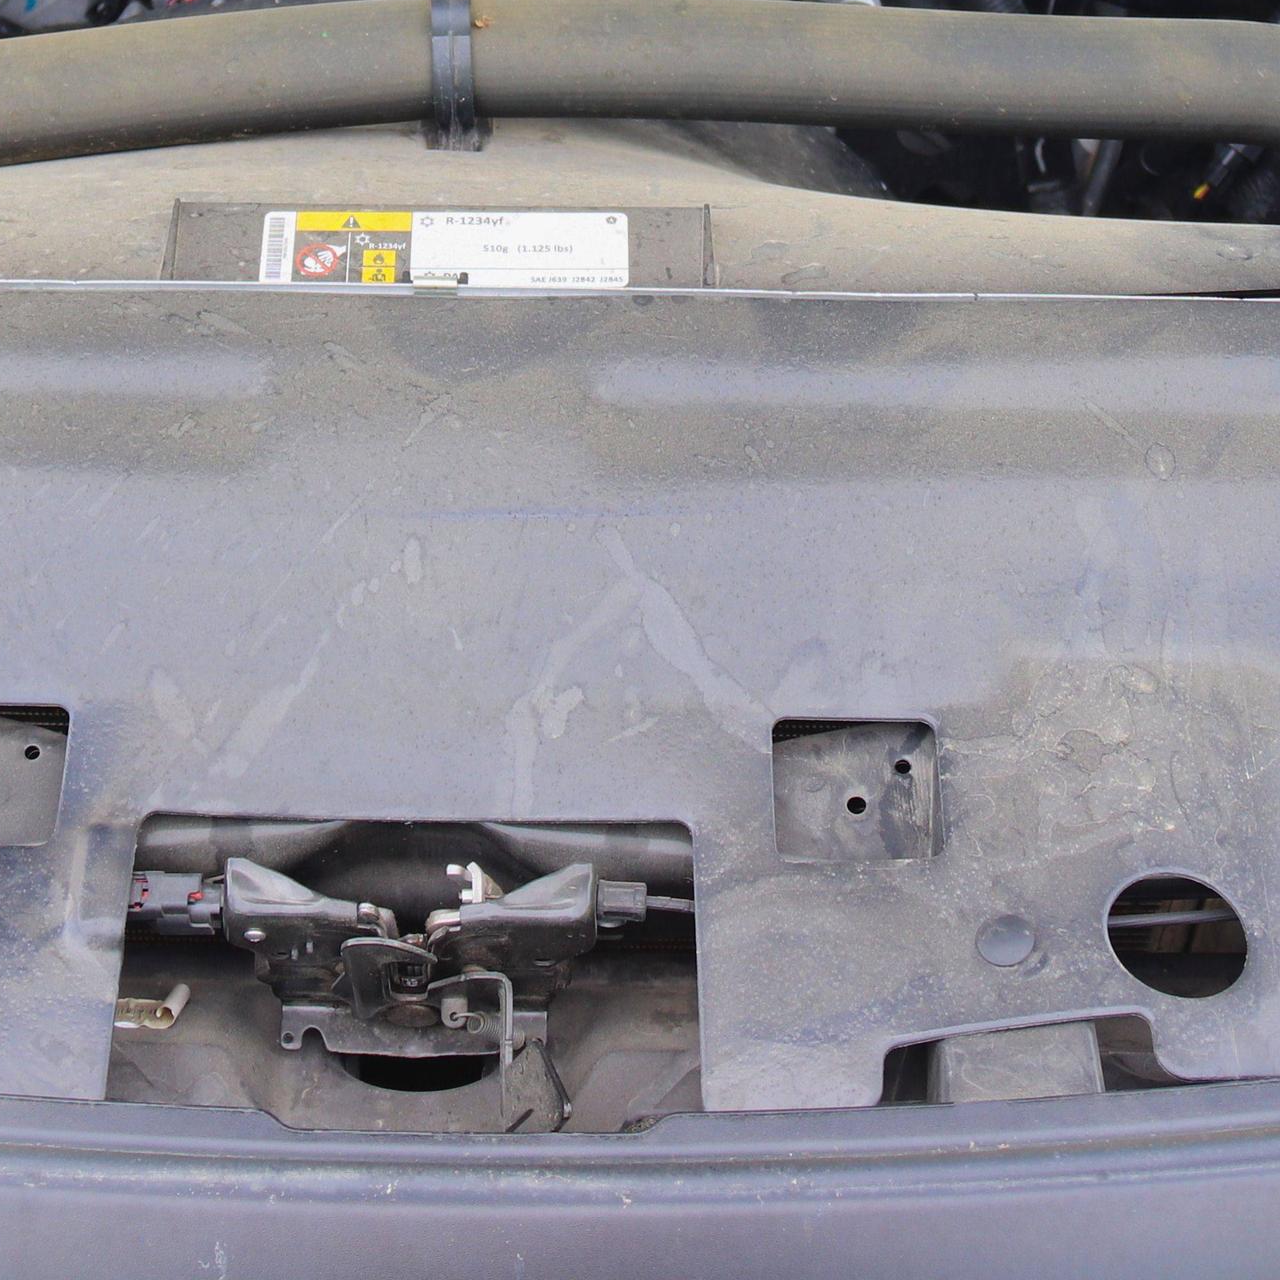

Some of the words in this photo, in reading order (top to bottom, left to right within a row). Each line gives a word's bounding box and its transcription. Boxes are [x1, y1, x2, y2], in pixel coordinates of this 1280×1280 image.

[446, 216, 504, 227] R-1234yf
[368, 242, 407, 250] R-1234yf
[482, 245, 509, 254] 510g
[553, 244, 573, 254] lbs)
